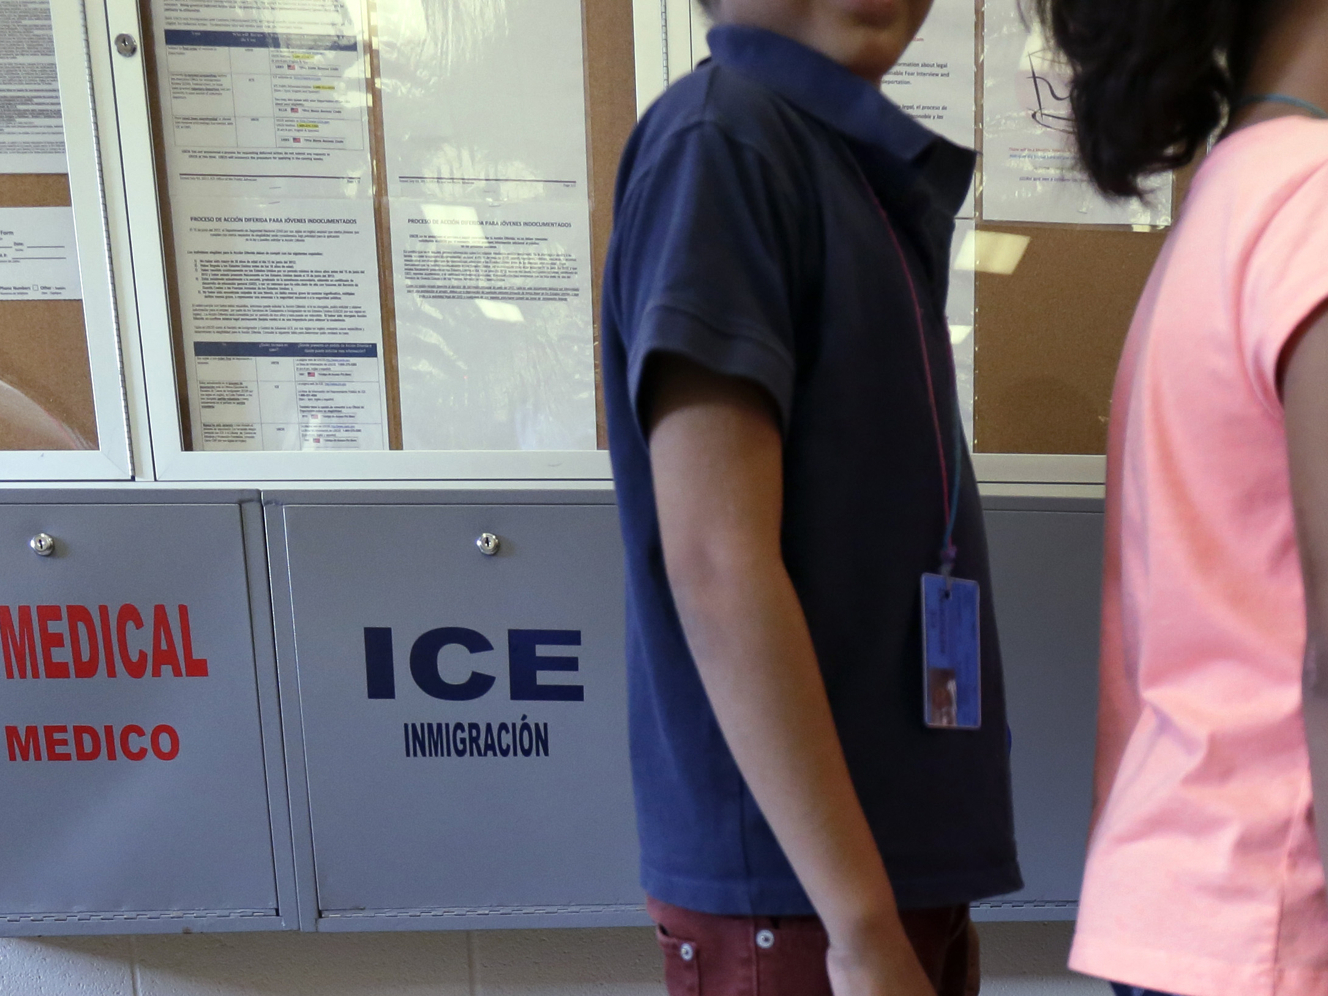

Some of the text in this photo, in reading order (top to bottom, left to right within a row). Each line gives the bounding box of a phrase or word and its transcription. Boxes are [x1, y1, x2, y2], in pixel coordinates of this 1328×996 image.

[0, 603, 208, 679] MEDICAL
[364, 627, 584, 701] ICE
[5, 724, 180, 761] MEDICO
[404, 714, 549, 757] INMIGRACIÓN
